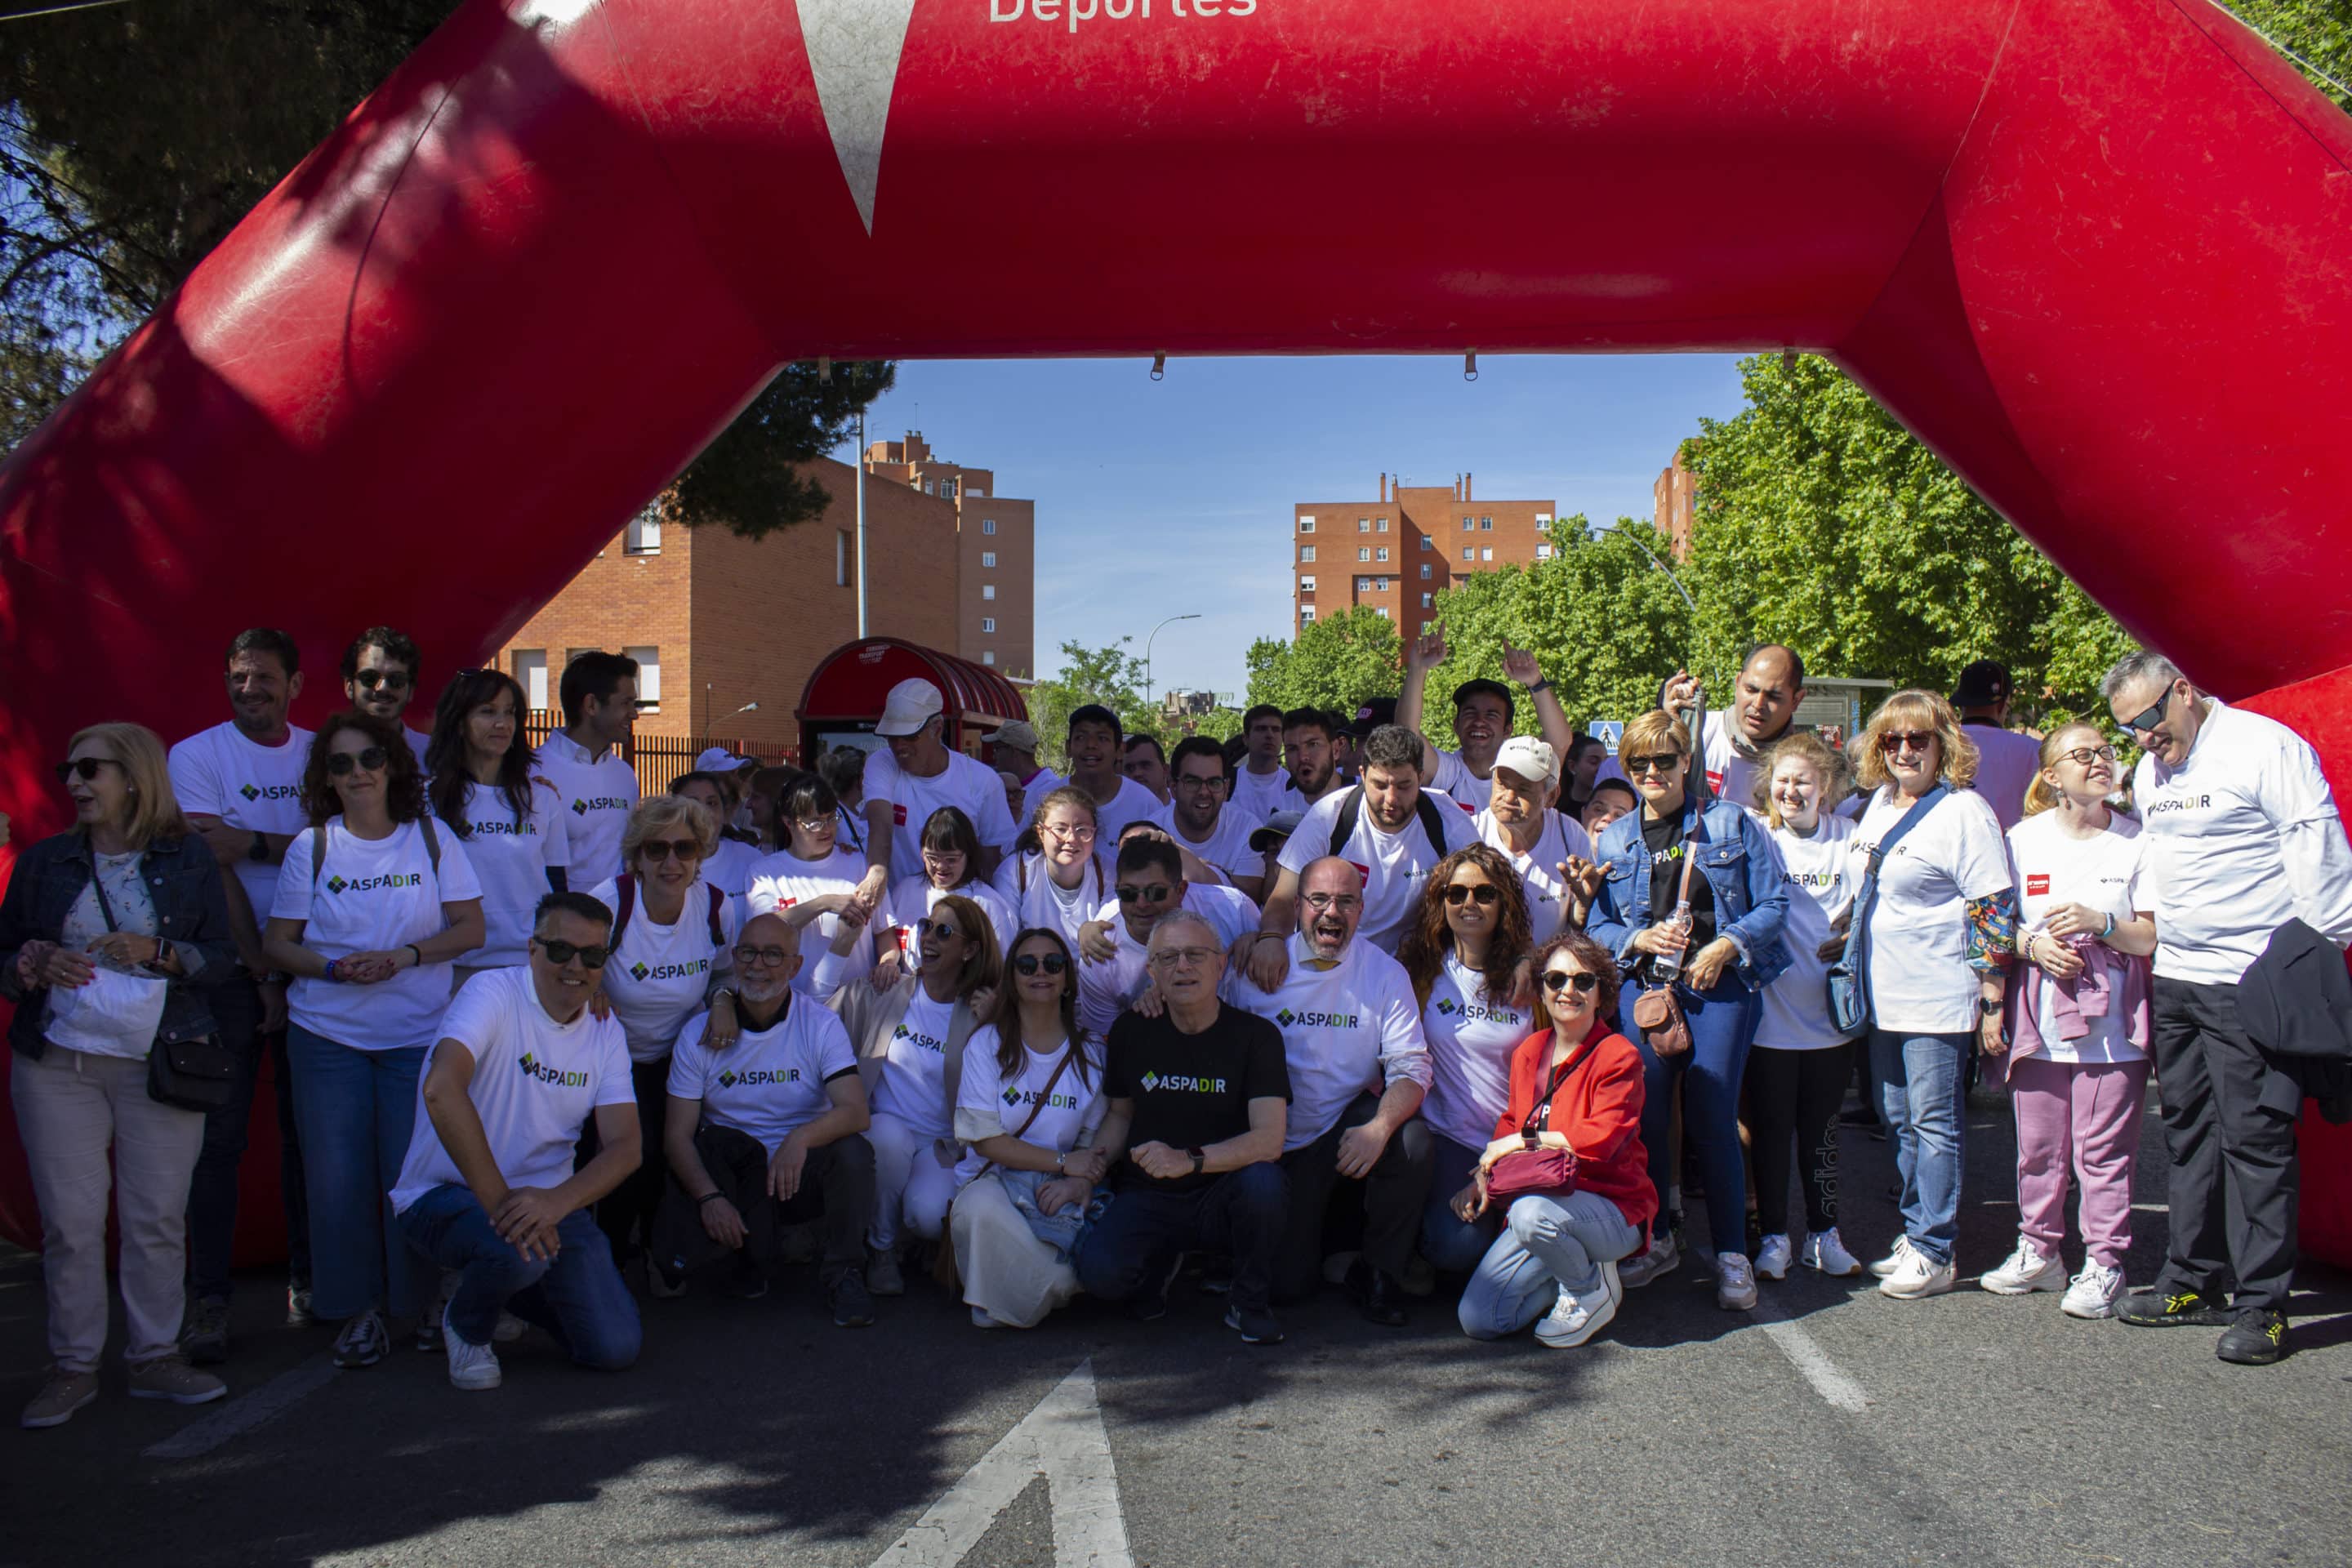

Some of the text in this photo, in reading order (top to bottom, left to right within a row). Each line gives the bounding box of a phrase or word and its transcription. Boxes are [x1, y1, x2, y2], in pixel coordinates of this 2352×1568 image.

[990, 0, 1257, 33] Deportes
[589, 798, 629, 811] ASPADIR
[2158, 795, 2211, 811] ASPADIR
[354, 873, 421, 892] ASPADIR
[1783, 872, 1842, 887] ASPADIR
[651, 959, 709, 980] ASPADIR
[1297, 1012, 1358, 1029] ASPADIR
[1456, 1004, 1519, 1027] ASPADIR
[738, 1068, 800, 1085] ASPADIR
[1160, 1075, 1227, 1094] ASPADIR
